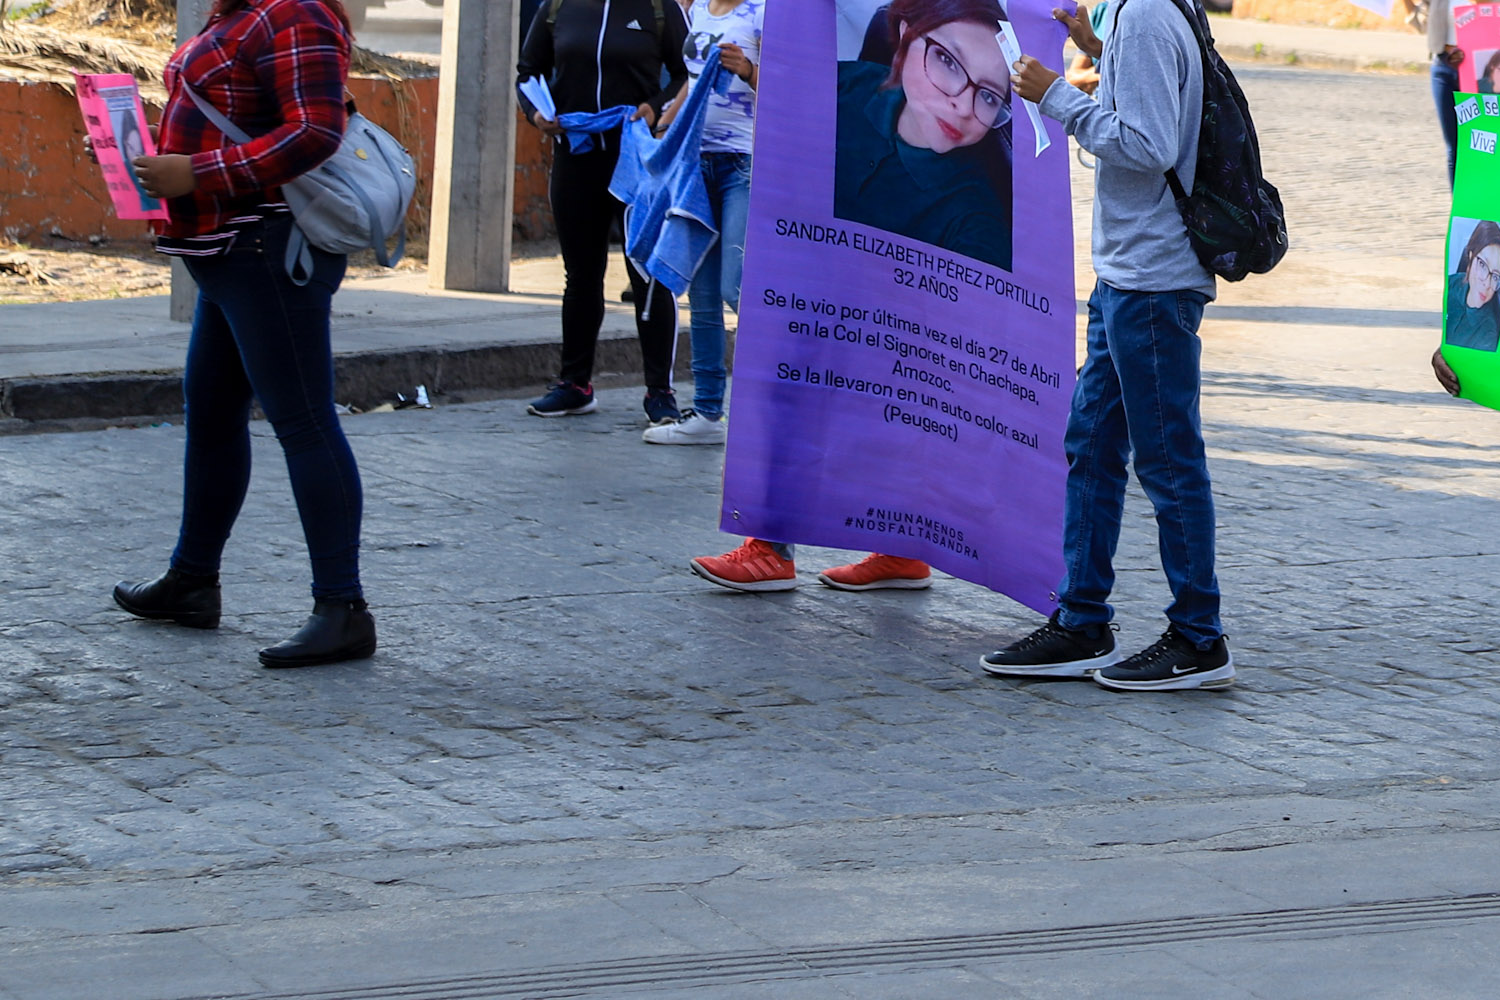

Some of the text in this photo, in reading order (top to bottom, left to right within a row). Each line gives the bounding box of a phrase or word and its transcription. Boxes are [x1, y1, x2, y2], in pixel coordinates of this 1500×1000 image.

[1485, 100, 1499, 115] se
[1471, 130, 1496, 153] Viva
[776, 219, 1053, 316] SANDRA ELIZABETH PÉREZ PORTILLO.
[893, 268, 959, 303] 32 AÑOS
[763, 289, 1060, 389] Se le vio por última vez el día 27 de Abril
[788, 320, 1039, 405] en la Col el Signoret en Chachapa,
[892, 360, 955, 394] Amozoc.
[777, 363, 1039, 449] Se la llevaron en un auto color azul
[883, 403, 959, 442] (Peugeot)
[844, 516, 979, 561] #NOSFALTASANDRA
[866, 507, 965, 542] #NIUNAMENOS
